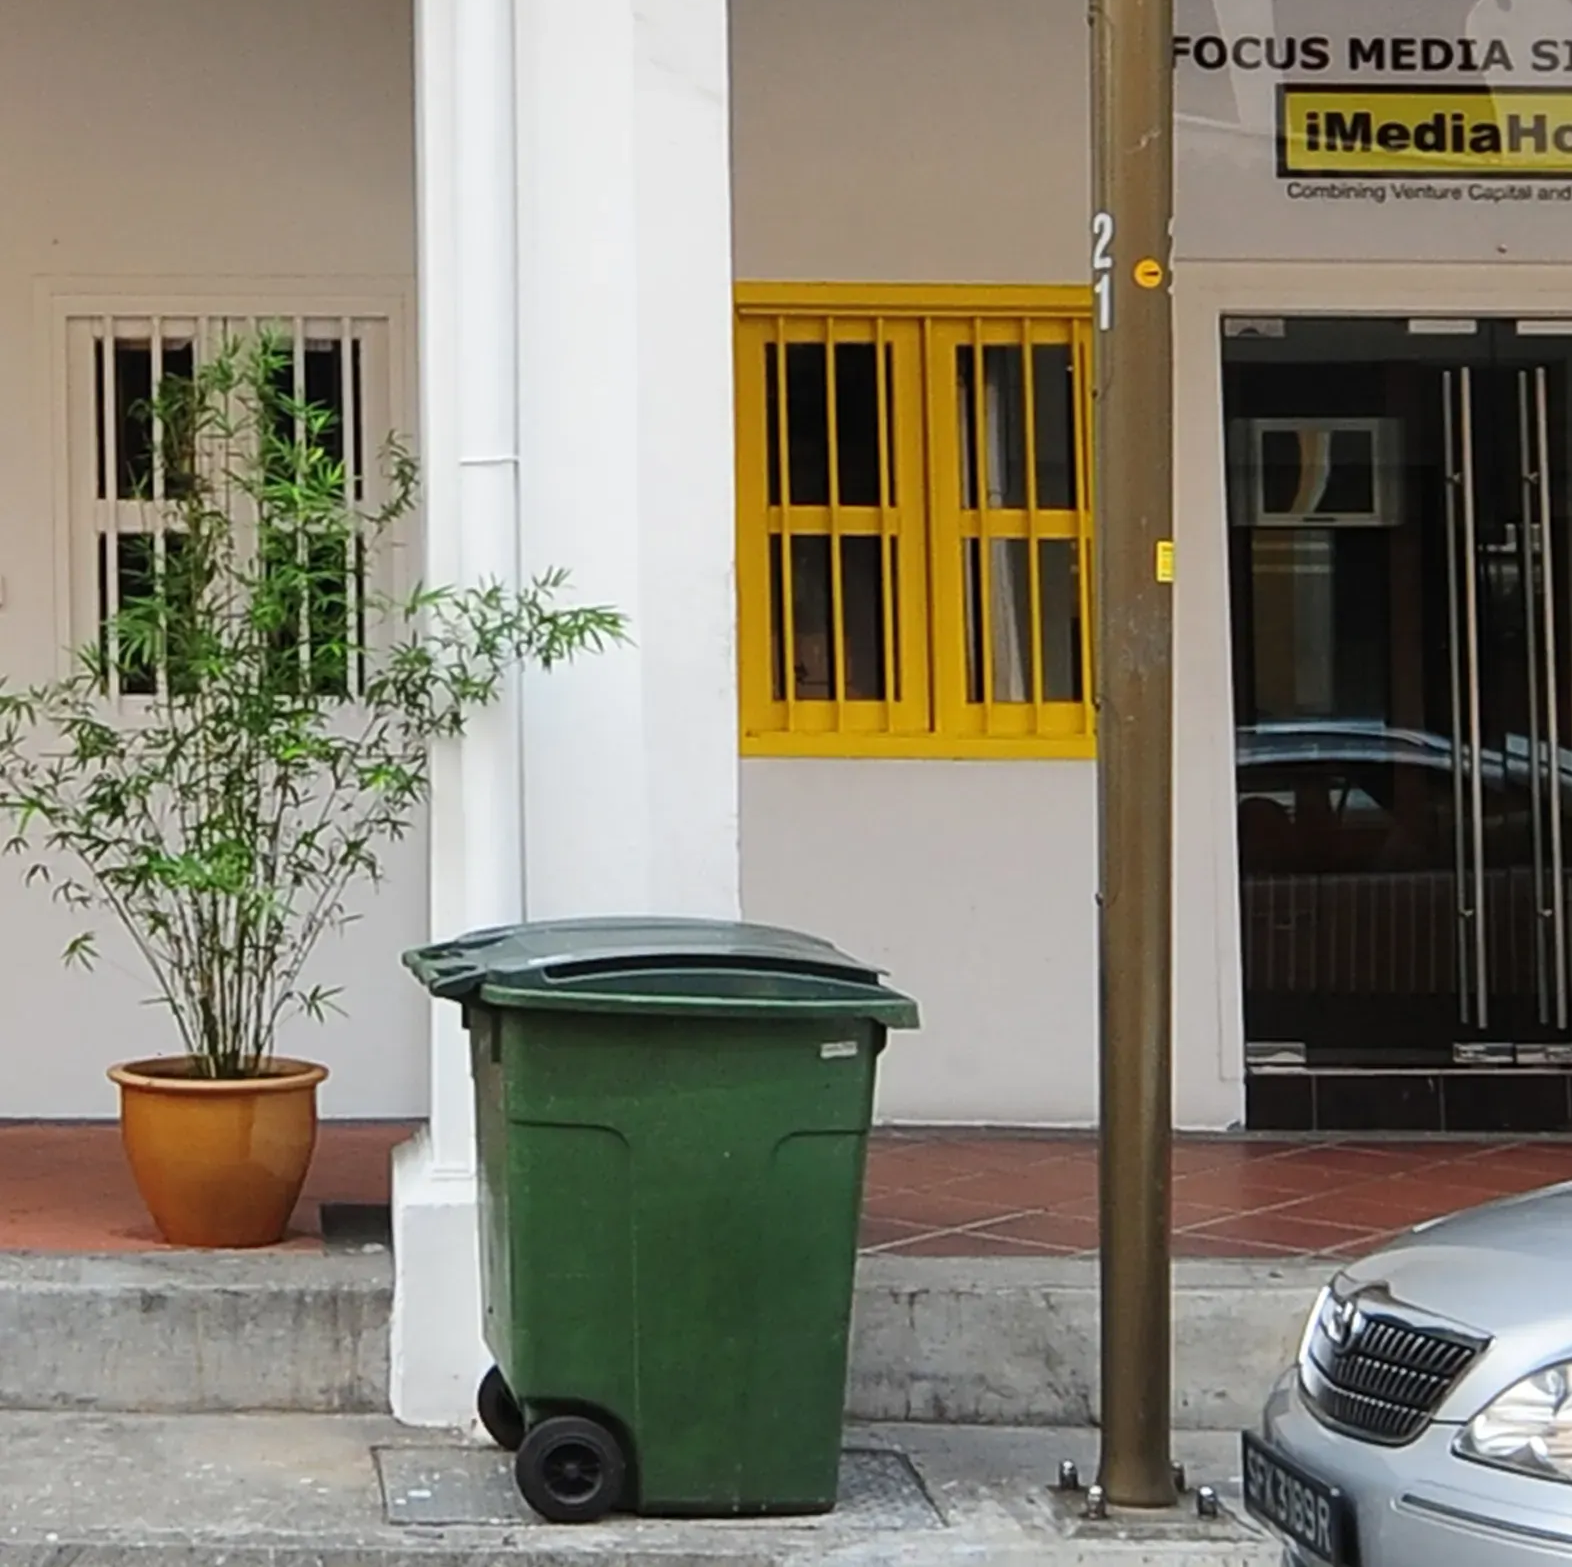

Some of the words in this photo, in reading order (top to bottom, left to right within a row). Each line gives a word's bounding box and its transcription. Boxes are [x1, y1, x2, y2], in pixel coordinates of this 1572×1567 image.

[1172, 36, 1330, 71] FOCUS
[1348, 37, 1514, 73] MEDIA
[1286, 181, 1387, 203] Combining
[1389, 182, 1463, 201] Venture
[1467, 183, 1533, 203] Capital
[1537, 185, 1572, 202] and
